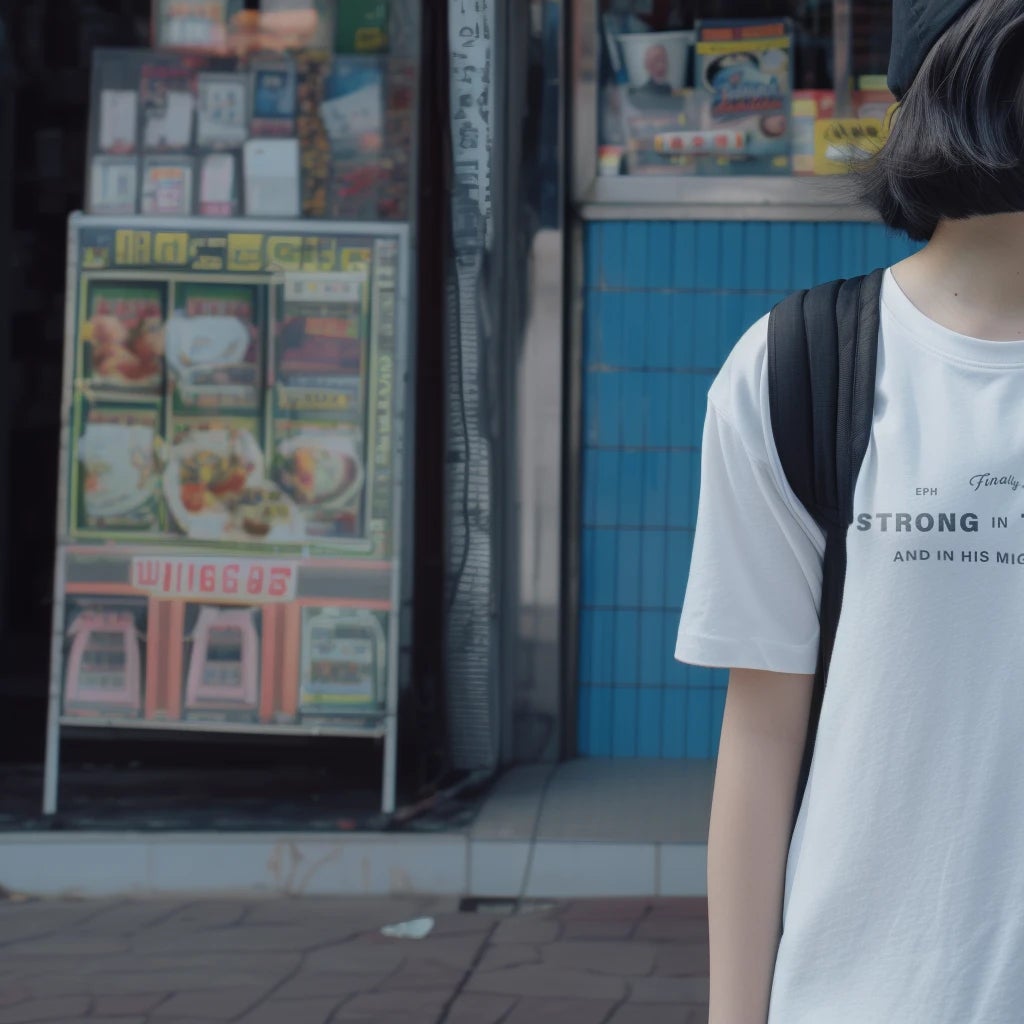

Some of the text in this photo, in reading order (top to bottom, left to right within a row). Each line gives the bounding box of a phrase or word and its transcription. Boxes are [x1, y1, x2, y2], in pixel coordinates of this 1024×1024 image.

[915, 487, 938, 496] EPH
[856, 513, 979, 533] STRONG
[991, 517, 1008, 529] IN
[893, 550, 931, 563] AND
[937, 550, 954, 563] IN
[961, 551, 990, 563] HIS
